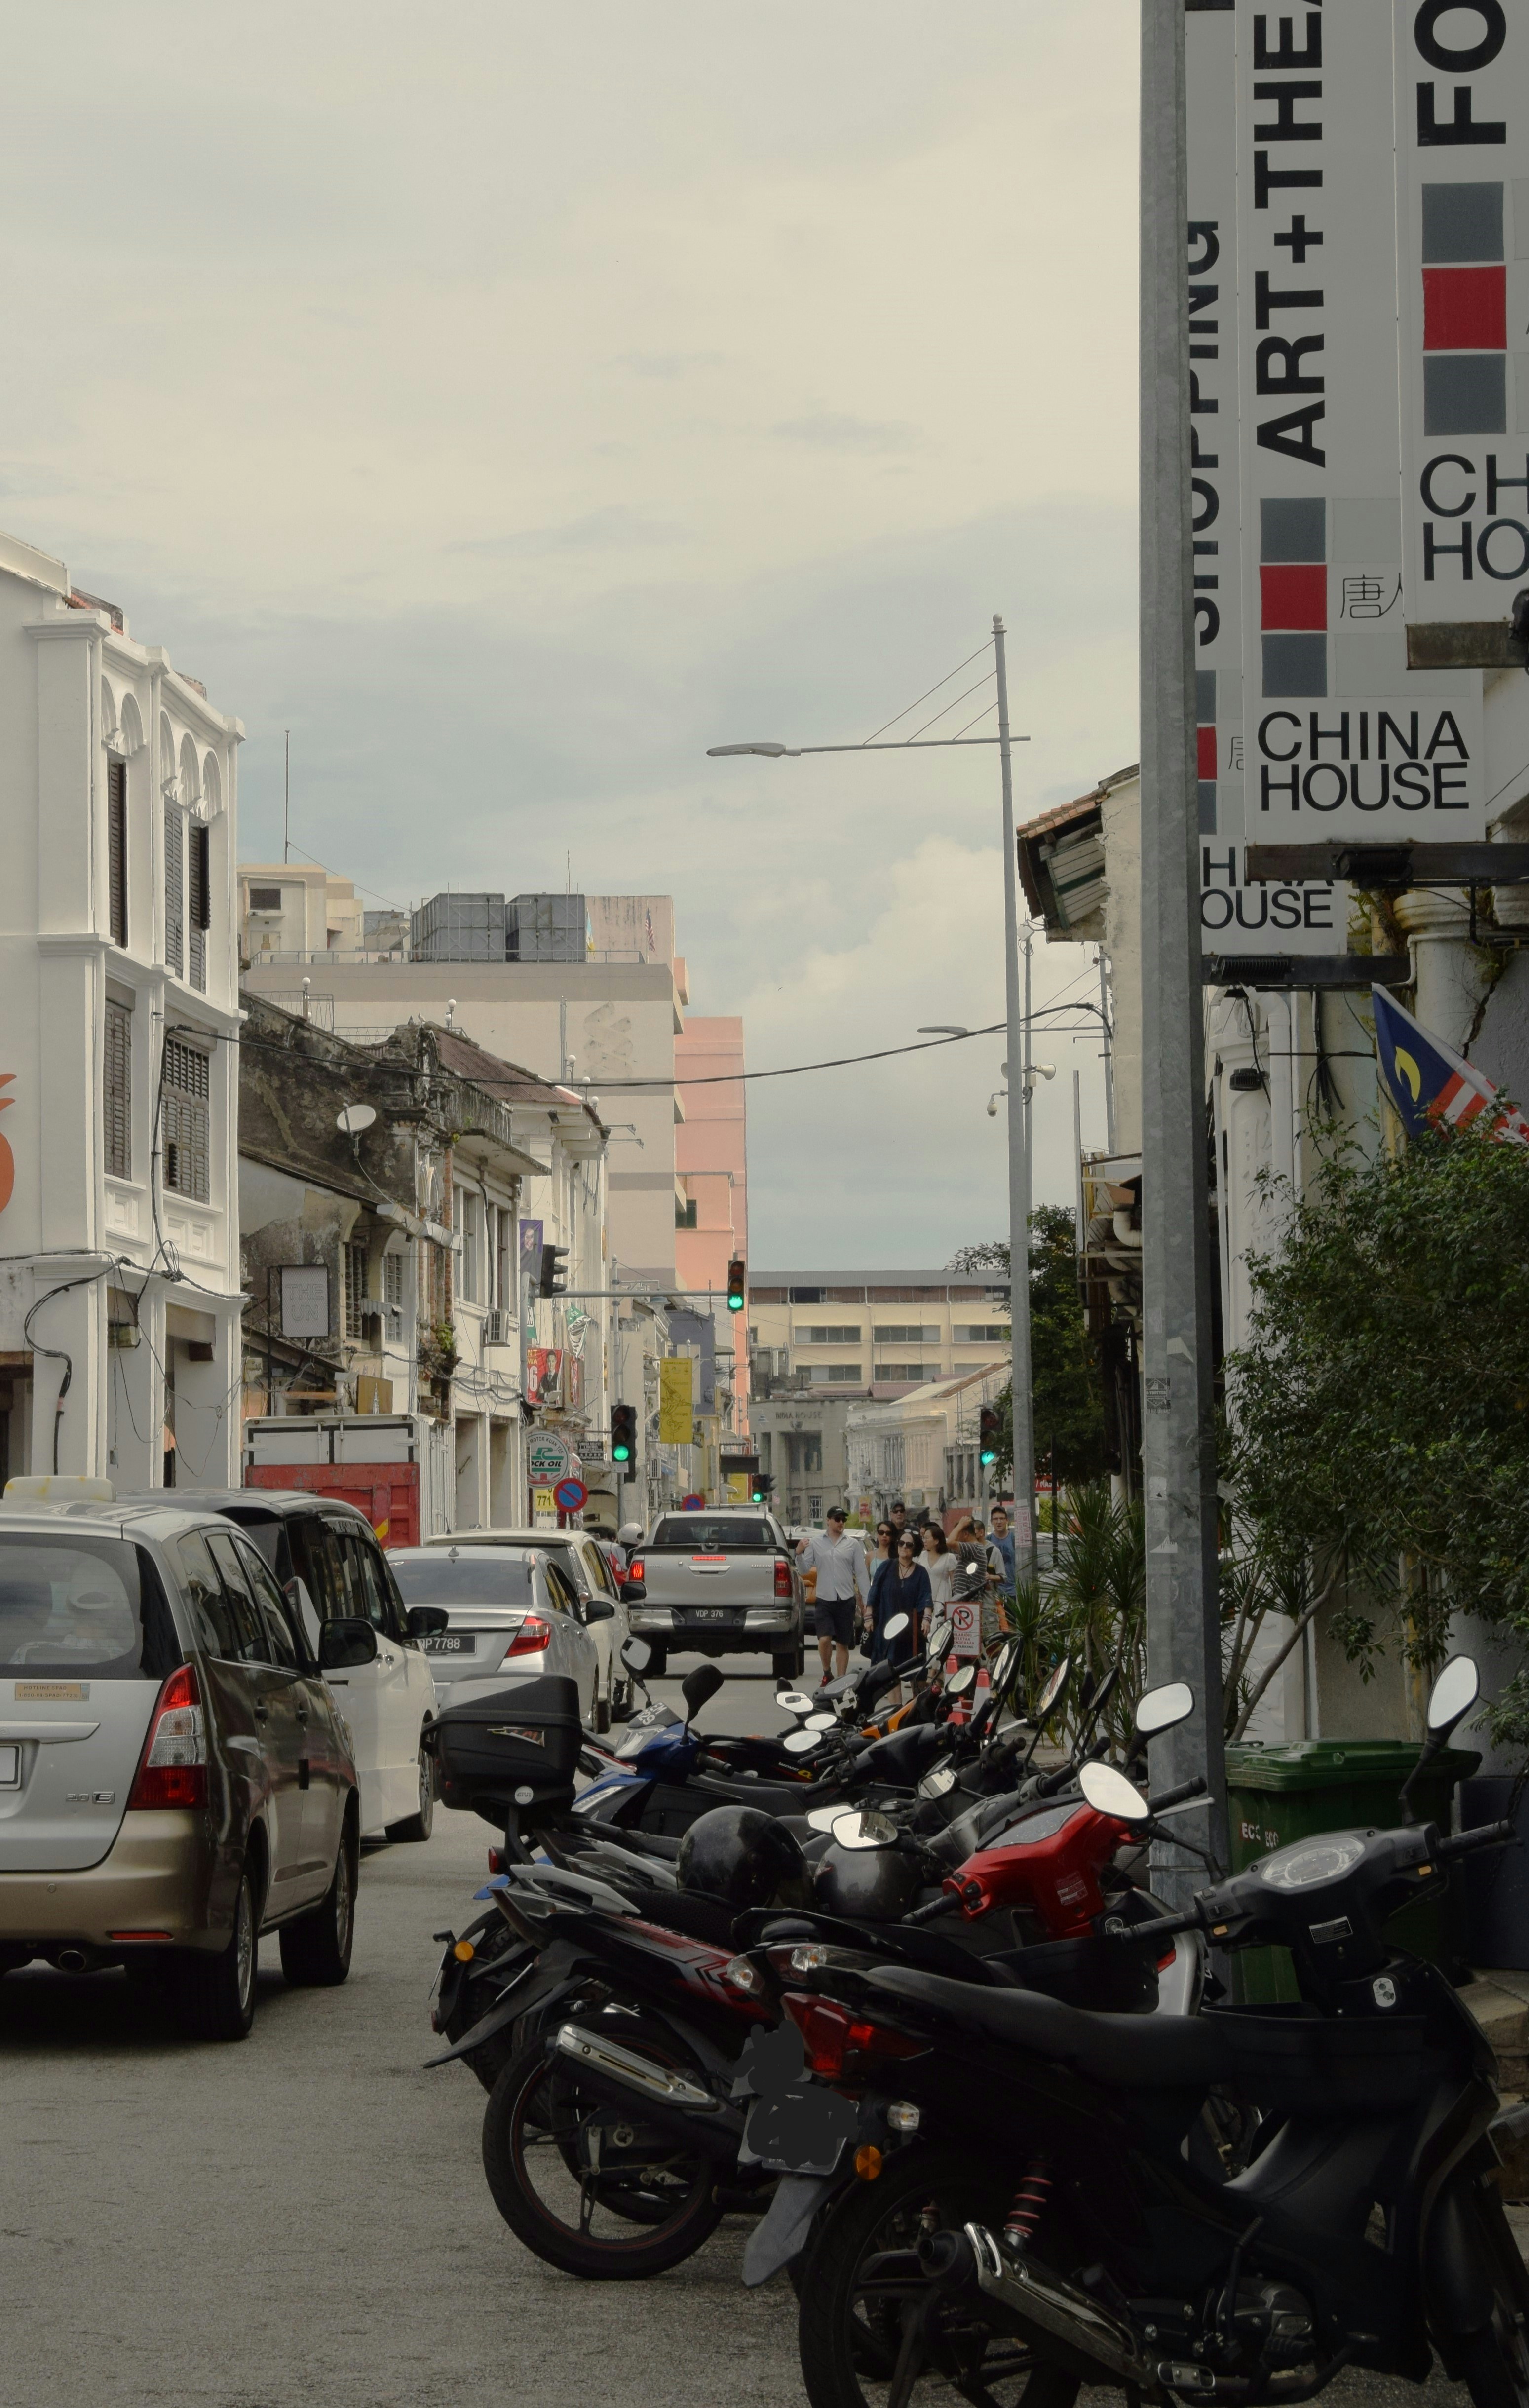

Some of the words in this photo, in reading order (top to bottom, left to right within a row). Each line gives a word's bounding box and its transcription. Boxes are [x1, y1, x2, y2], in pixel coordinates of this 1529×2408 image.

[1254, 0, 1325, 467] ART+THE
[1258, 711, 1470, 761] CHINA
[1261, 762, 1469, 812] HOUSE
[1201, 889, 1333, 929] OUSE
[285, 1284, 324, 1300] THE
[546, 1437, 558, 1447] KUAN
[537, 1495, 551, 1506] 771
[434, 1638, 460, 1649] 7788
